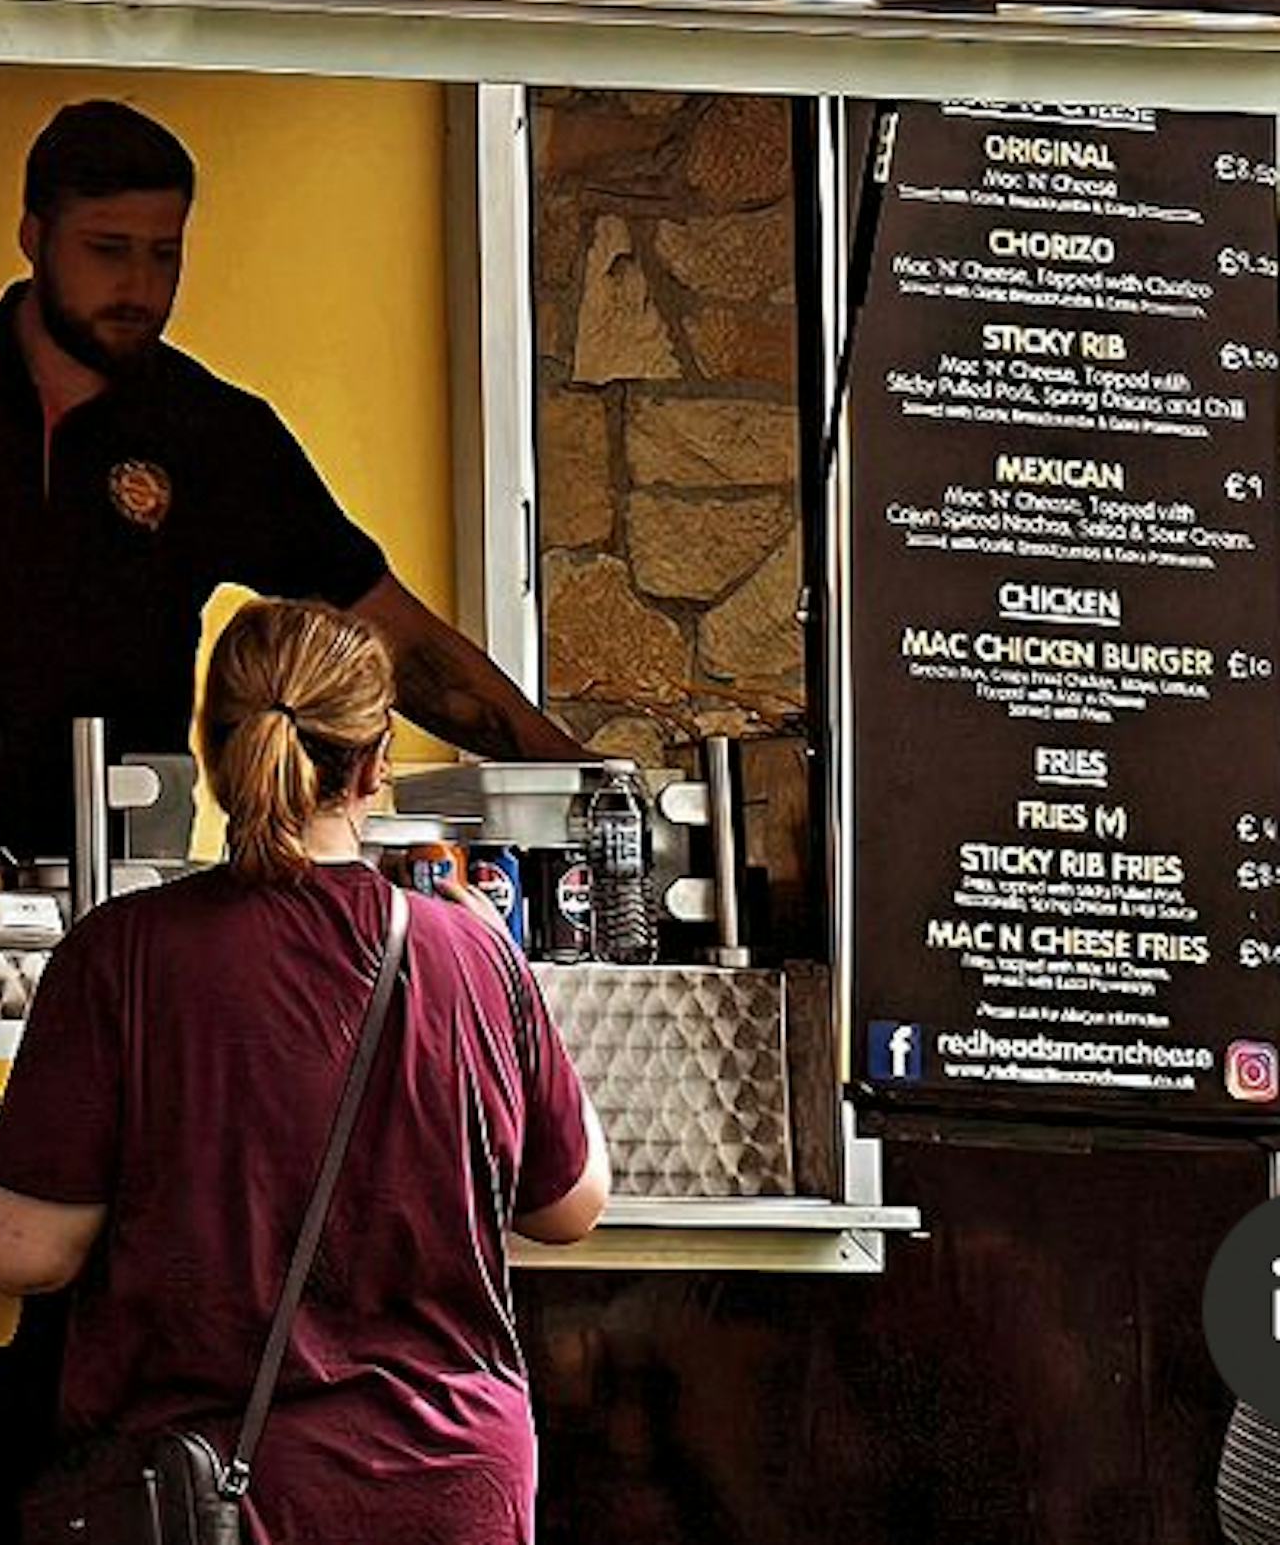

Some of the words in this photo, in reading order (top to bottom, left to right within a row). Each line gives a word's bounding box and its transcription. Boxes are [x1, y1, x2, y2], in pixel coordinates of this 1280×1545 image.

[985, 134, 1117, 170] ORIGINAL
[983, 167, 1022, 190] Mac
[1050, 172, 1118, 199] Cheese
[989, 227, 1115, 264] CHORIZO
[892, 255, 931, 277] Mac
[1037, 265, 1104, 294] Topped
[1105, 273, 1143, 293] with
[1145, 275, 1214, 300] Chorizo
[983, 323, 1077, 357] STICKY
[1081, 330, 1128, 361] RIB
[939, 353, 979, 376] Mac
[1083, 363, 1150, 392] Topped
[886, 369, 937, 399] Sticky
[939, 374, 993, 400] Pulled
[1043, 385, 1098, 413] Spring
[1100, 390, 1164, 415] Onions
[1165, 396, 1202, 418] and
[996, 454, 1125, 492] MEXICAN
[886, 501, 940, 530] Cajun
[941, 505, 1001, 532] Spiced
[1077, 518, 1127, 542] Salsa
[1147, 523, 1189, 544] Sour
[944, 485, 986, 508] Mac
[1089, 494, 1156, 523] Topped
[1157, 501, 1196, 523] with
[999, 582, 1121, 619] CHICKEN
[902, 626, 970, 660] MAC
[973, 632, 1096, 670] CHICKEN
[1102, 640, 1215, 677] BURGER
[1035, 745, 1108, 778] FRIES
[1016, 800, 1089, 834] FRIES
[960, 842, 1056, 876] STICKY
[1059, 848, 1106, 879] RIB
[1111, 851, 1185, 885] FRIES
[924, 918, 996, 950] MAC
[998, 922, 1024, 953] N
[1029, 925, 1133, 959] CHEESE
[1137, 932, 1211, 966] FRIES
[937, 1027, 1215, 1071] redheadsmacncheese
